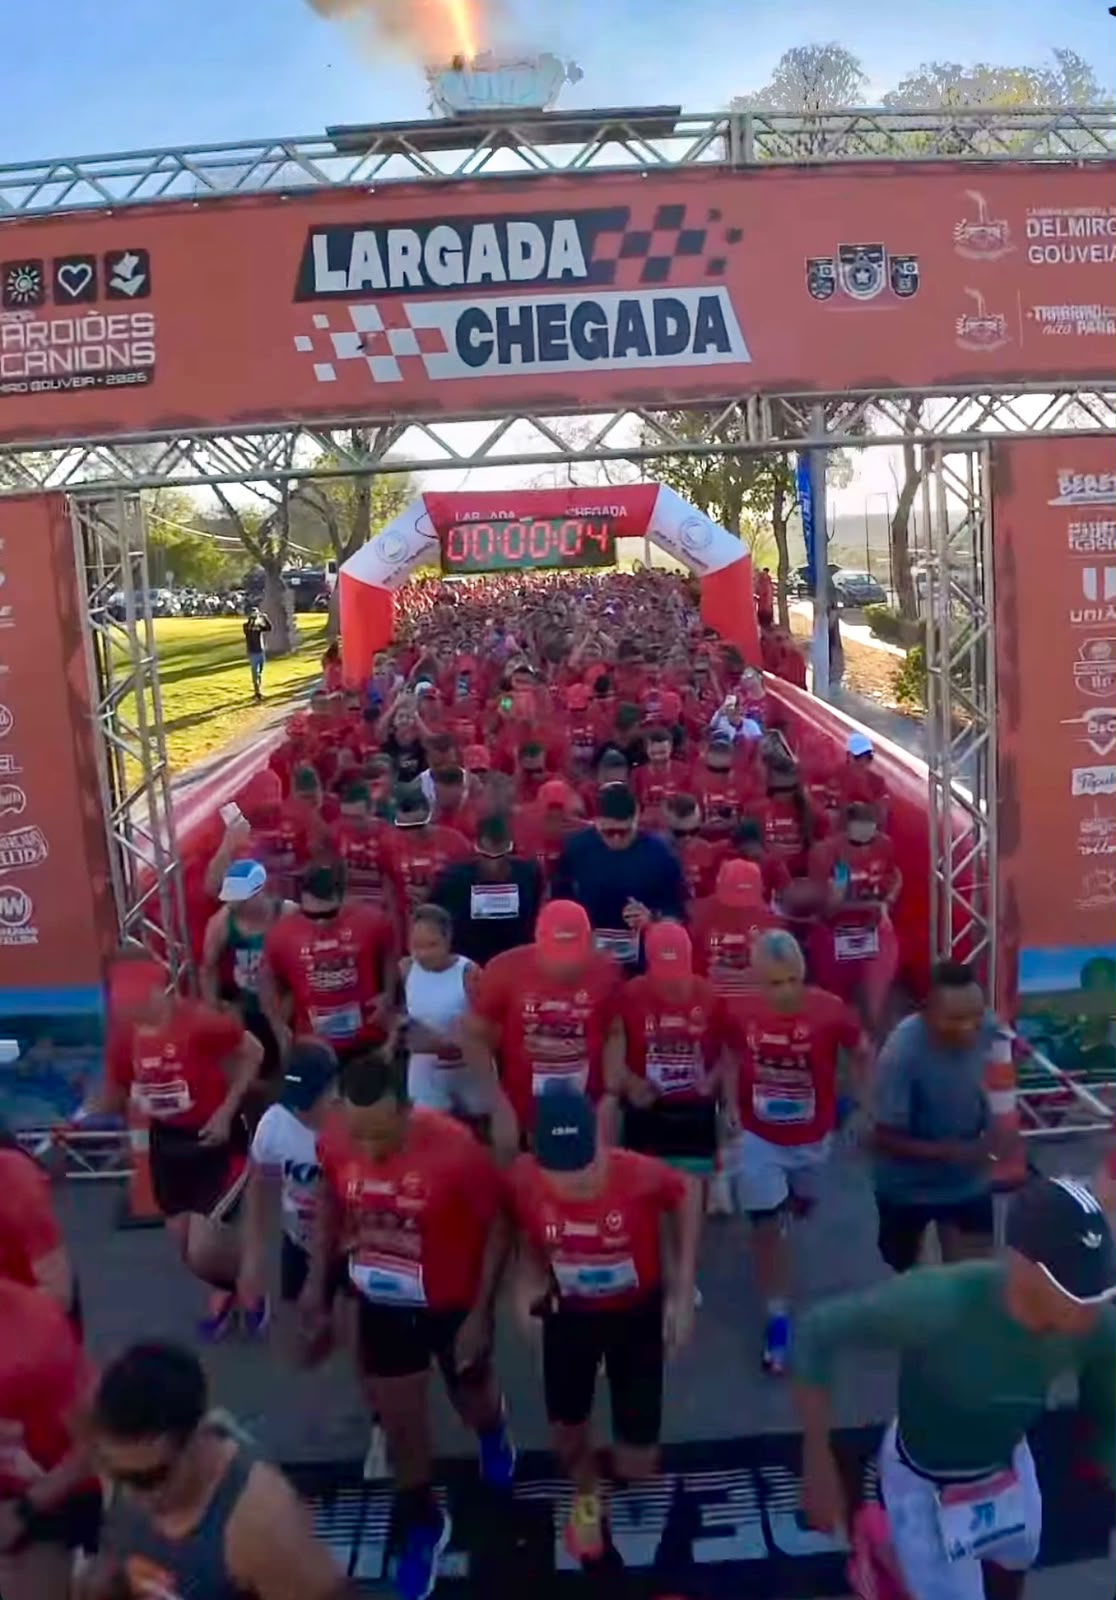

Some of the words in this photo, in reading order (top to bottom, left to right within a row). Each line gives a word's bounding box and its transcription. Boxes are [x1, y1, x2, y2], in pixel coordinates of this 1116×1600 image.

[312, 219, 588, 293] LARGADA
[455, 295, 732, 368] CHEGADA
[447, 518, 608, 562] 00:00:04
